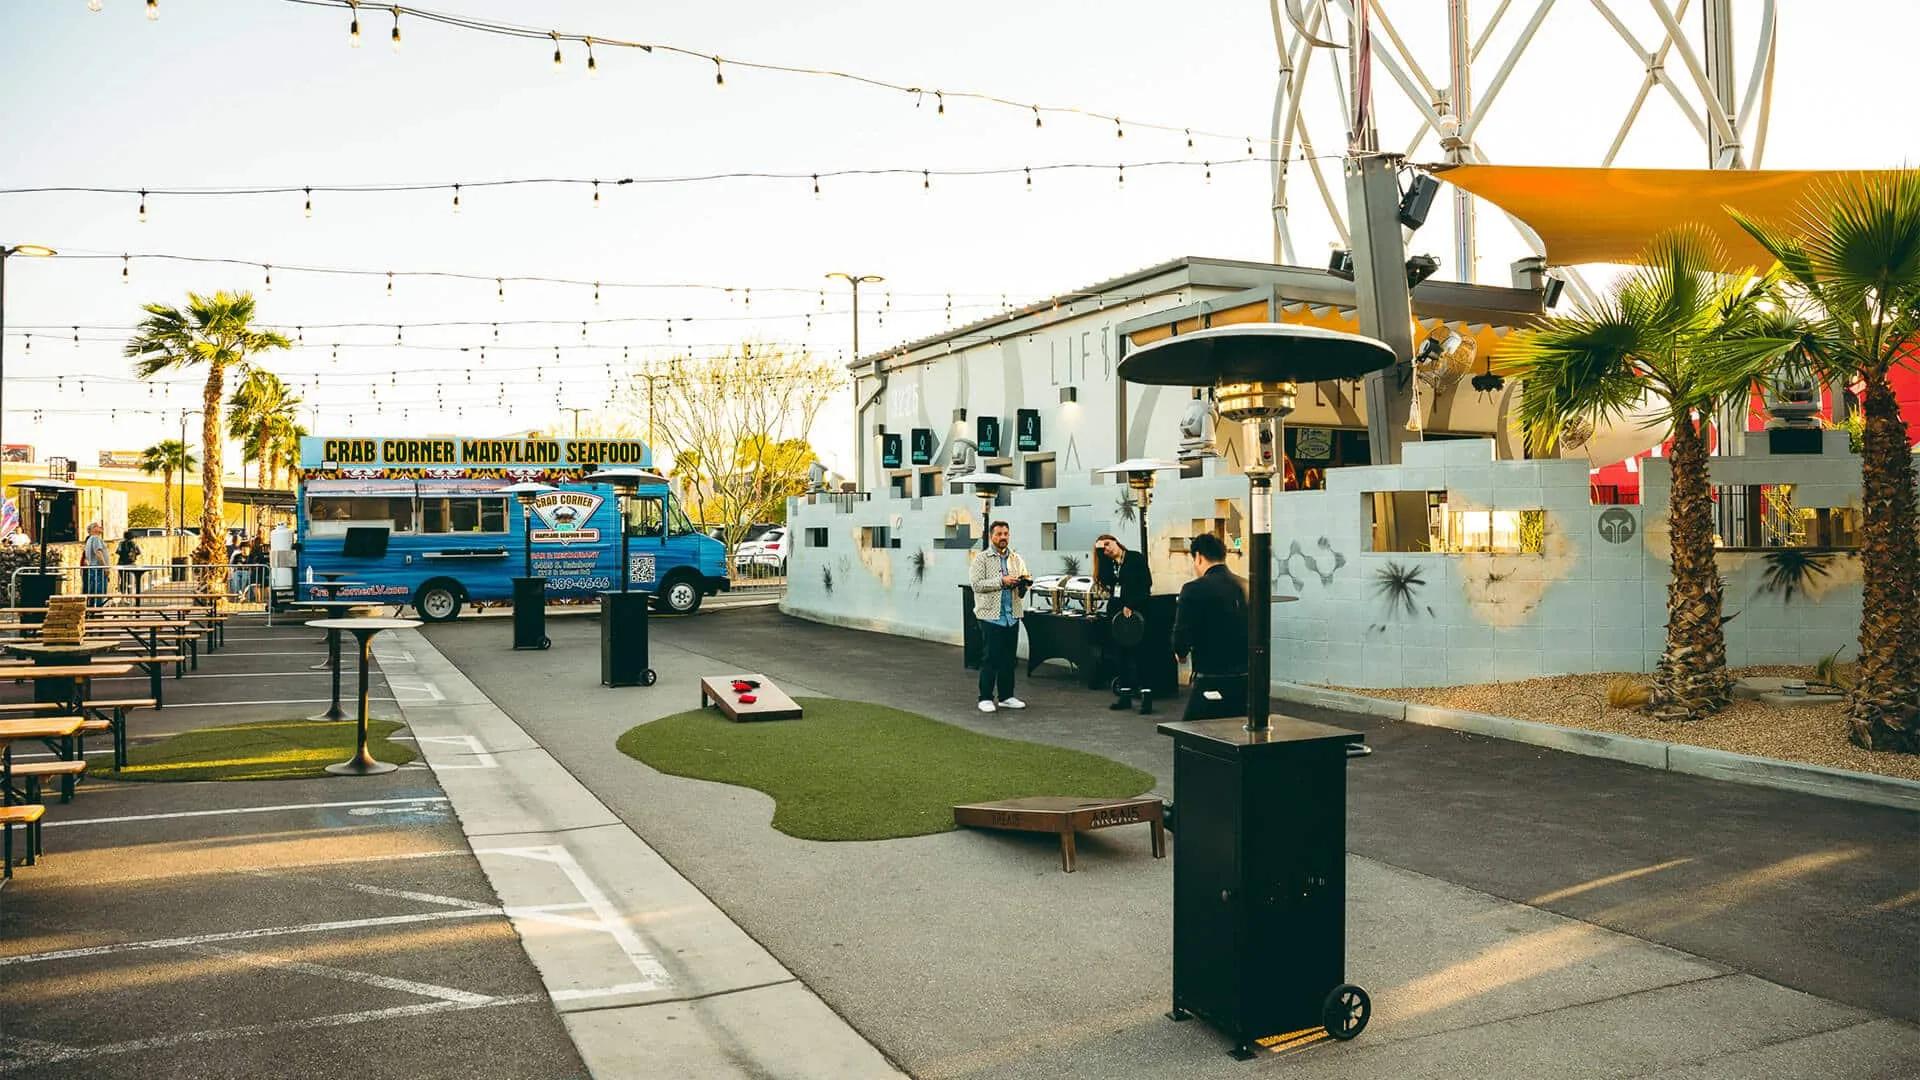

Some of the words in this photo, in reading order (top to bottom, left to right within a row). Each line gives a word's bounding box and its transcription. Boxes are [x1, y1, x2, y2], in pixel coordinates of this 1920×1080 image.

[325, 440, 377, 464] CRAB
[382, 440, 456, 464] CORNER
[461, 440, 560, 464] MARYLAND
[565, 440, 642, 464] SEAFOOD
[536, 495, 558, 509] CRAB
[560, 494, 594, 508] CORNER
[309, 584, 409, 597] CraCornerLV.com
[544, 577, 610, 590] -489-4646
